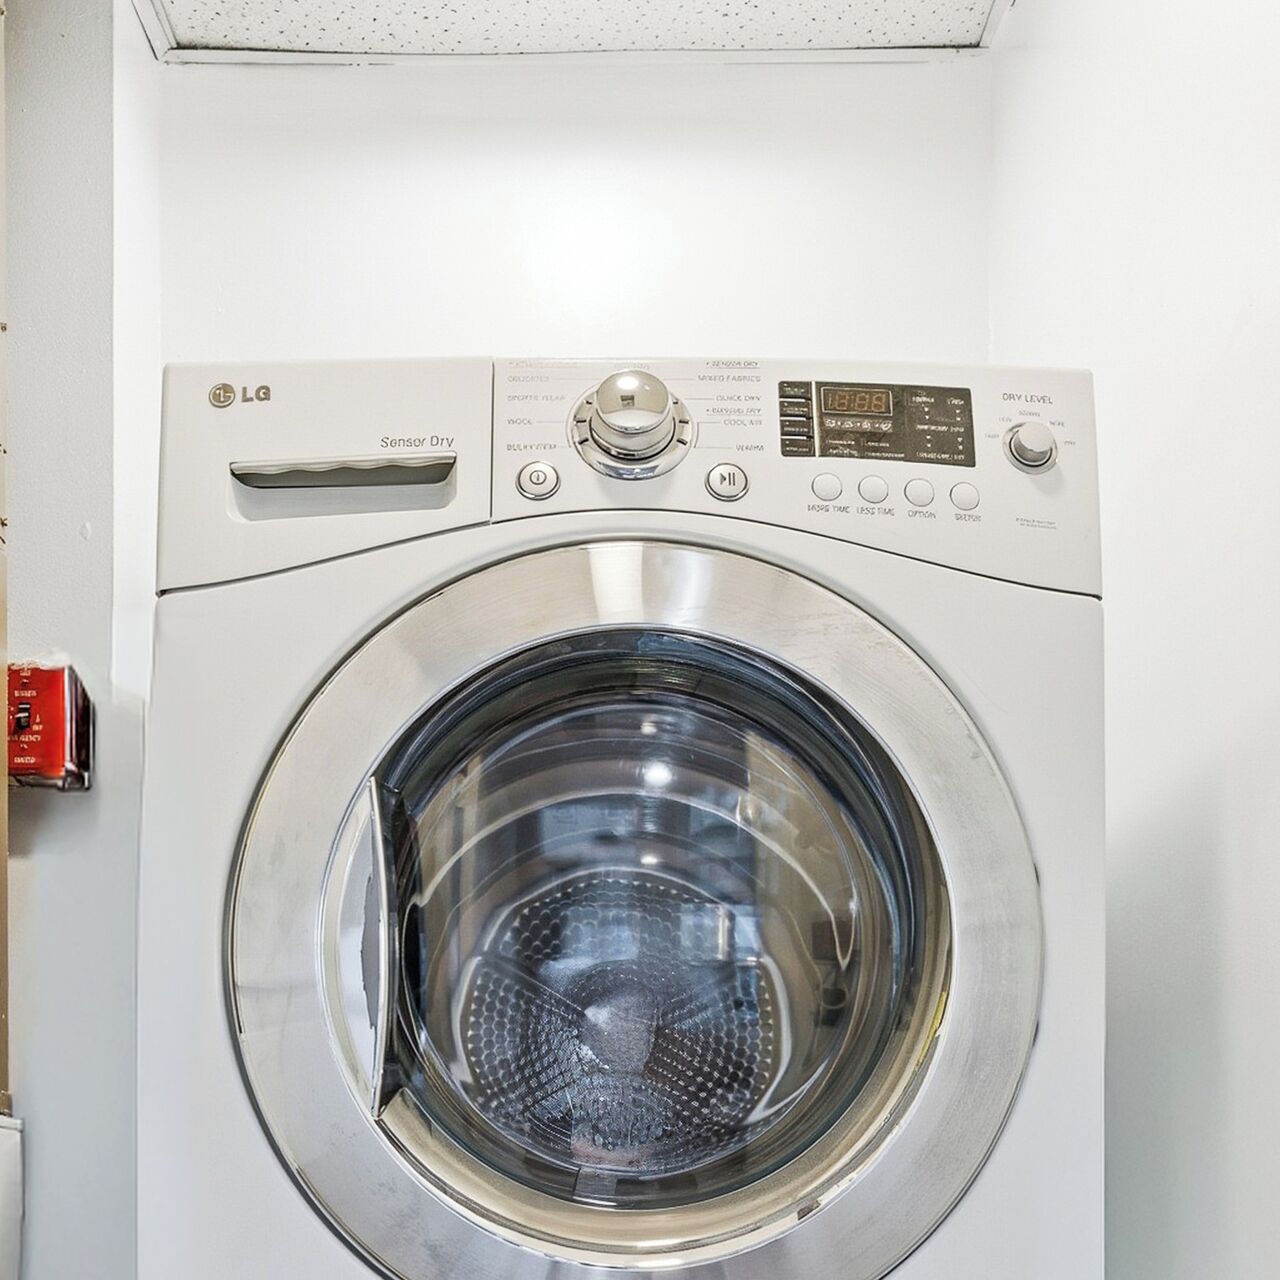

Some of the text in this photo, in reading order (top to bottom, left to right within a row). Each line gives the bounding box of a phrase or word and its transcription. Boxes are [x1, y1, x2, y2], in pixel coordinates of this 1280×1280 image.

[241, 386, 271, 402] LG
[1002, 392, 1054, 404] DRY LEVEL
[380, 435, 455, 449] Sensor Dry
